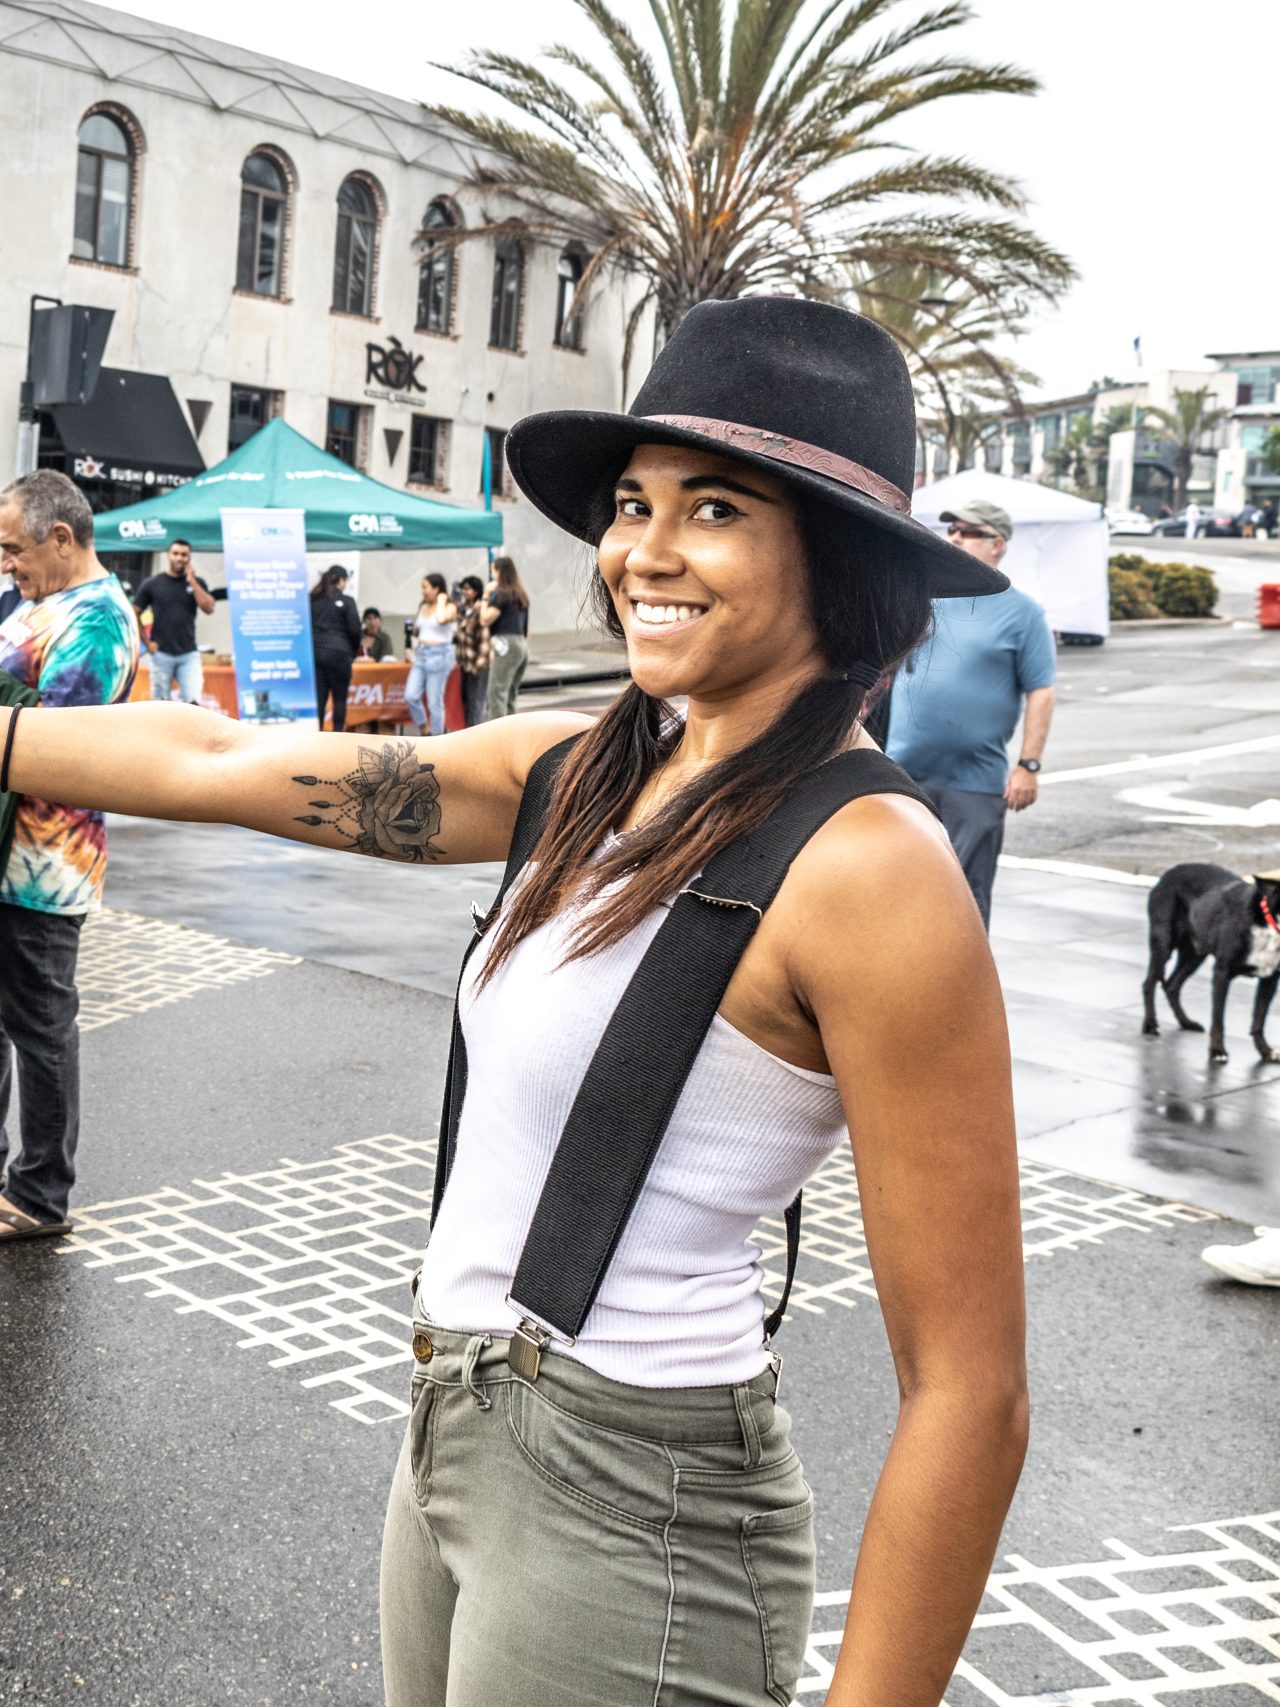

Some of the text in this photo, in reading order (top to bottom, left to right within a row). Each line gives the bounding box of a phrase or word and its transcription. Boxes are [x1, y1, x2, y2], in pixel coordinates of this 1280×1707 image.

[110, 467, 143, 482] SUSHI
[119, 519, 146, 538] CPA
[349, 514, 379, 534] CPA
